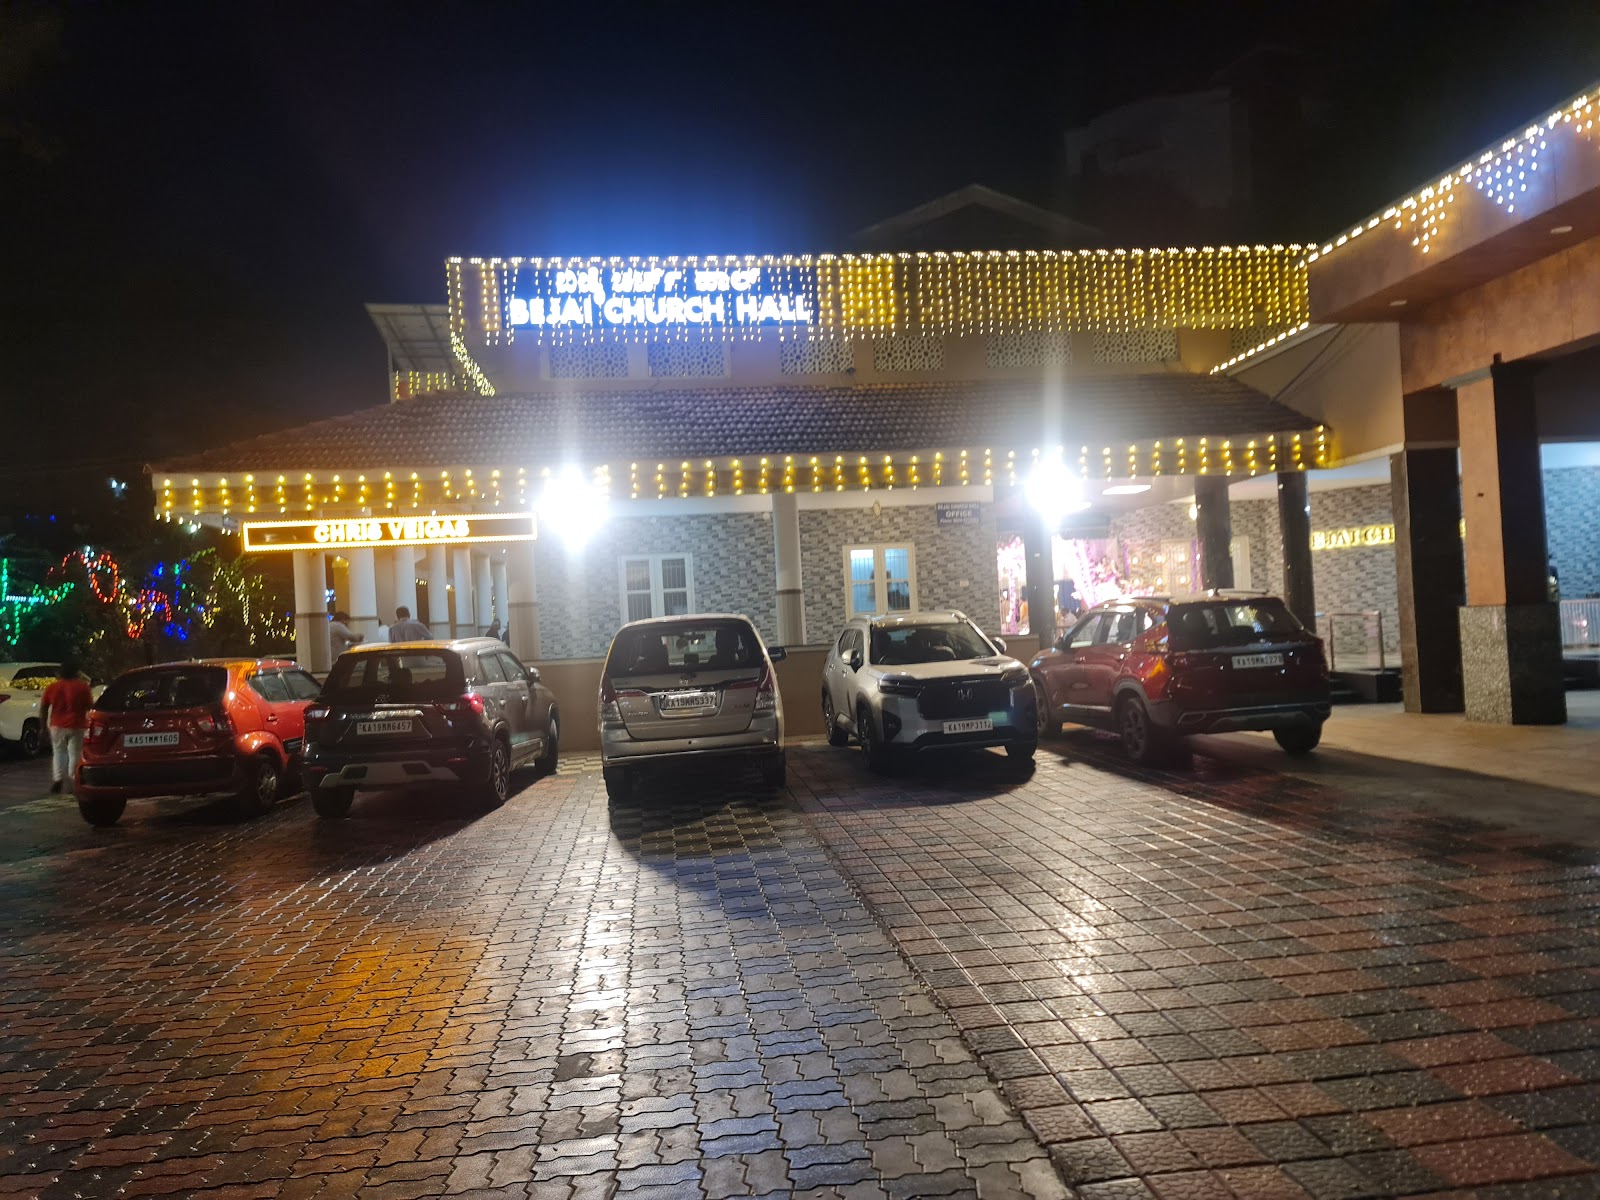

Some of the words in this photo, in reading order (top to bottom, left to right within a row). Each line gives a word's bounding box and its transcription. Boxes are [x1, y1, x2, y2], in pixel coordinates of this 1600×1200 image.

[509, 297, 593, 326] BEJAI
[603, 296, 724, 325] CHURCH
[736, 296, 811, 322] HALL
[945, 510, 973, 519] OFFICE
[313, 523, 383, 543] CHRIS
